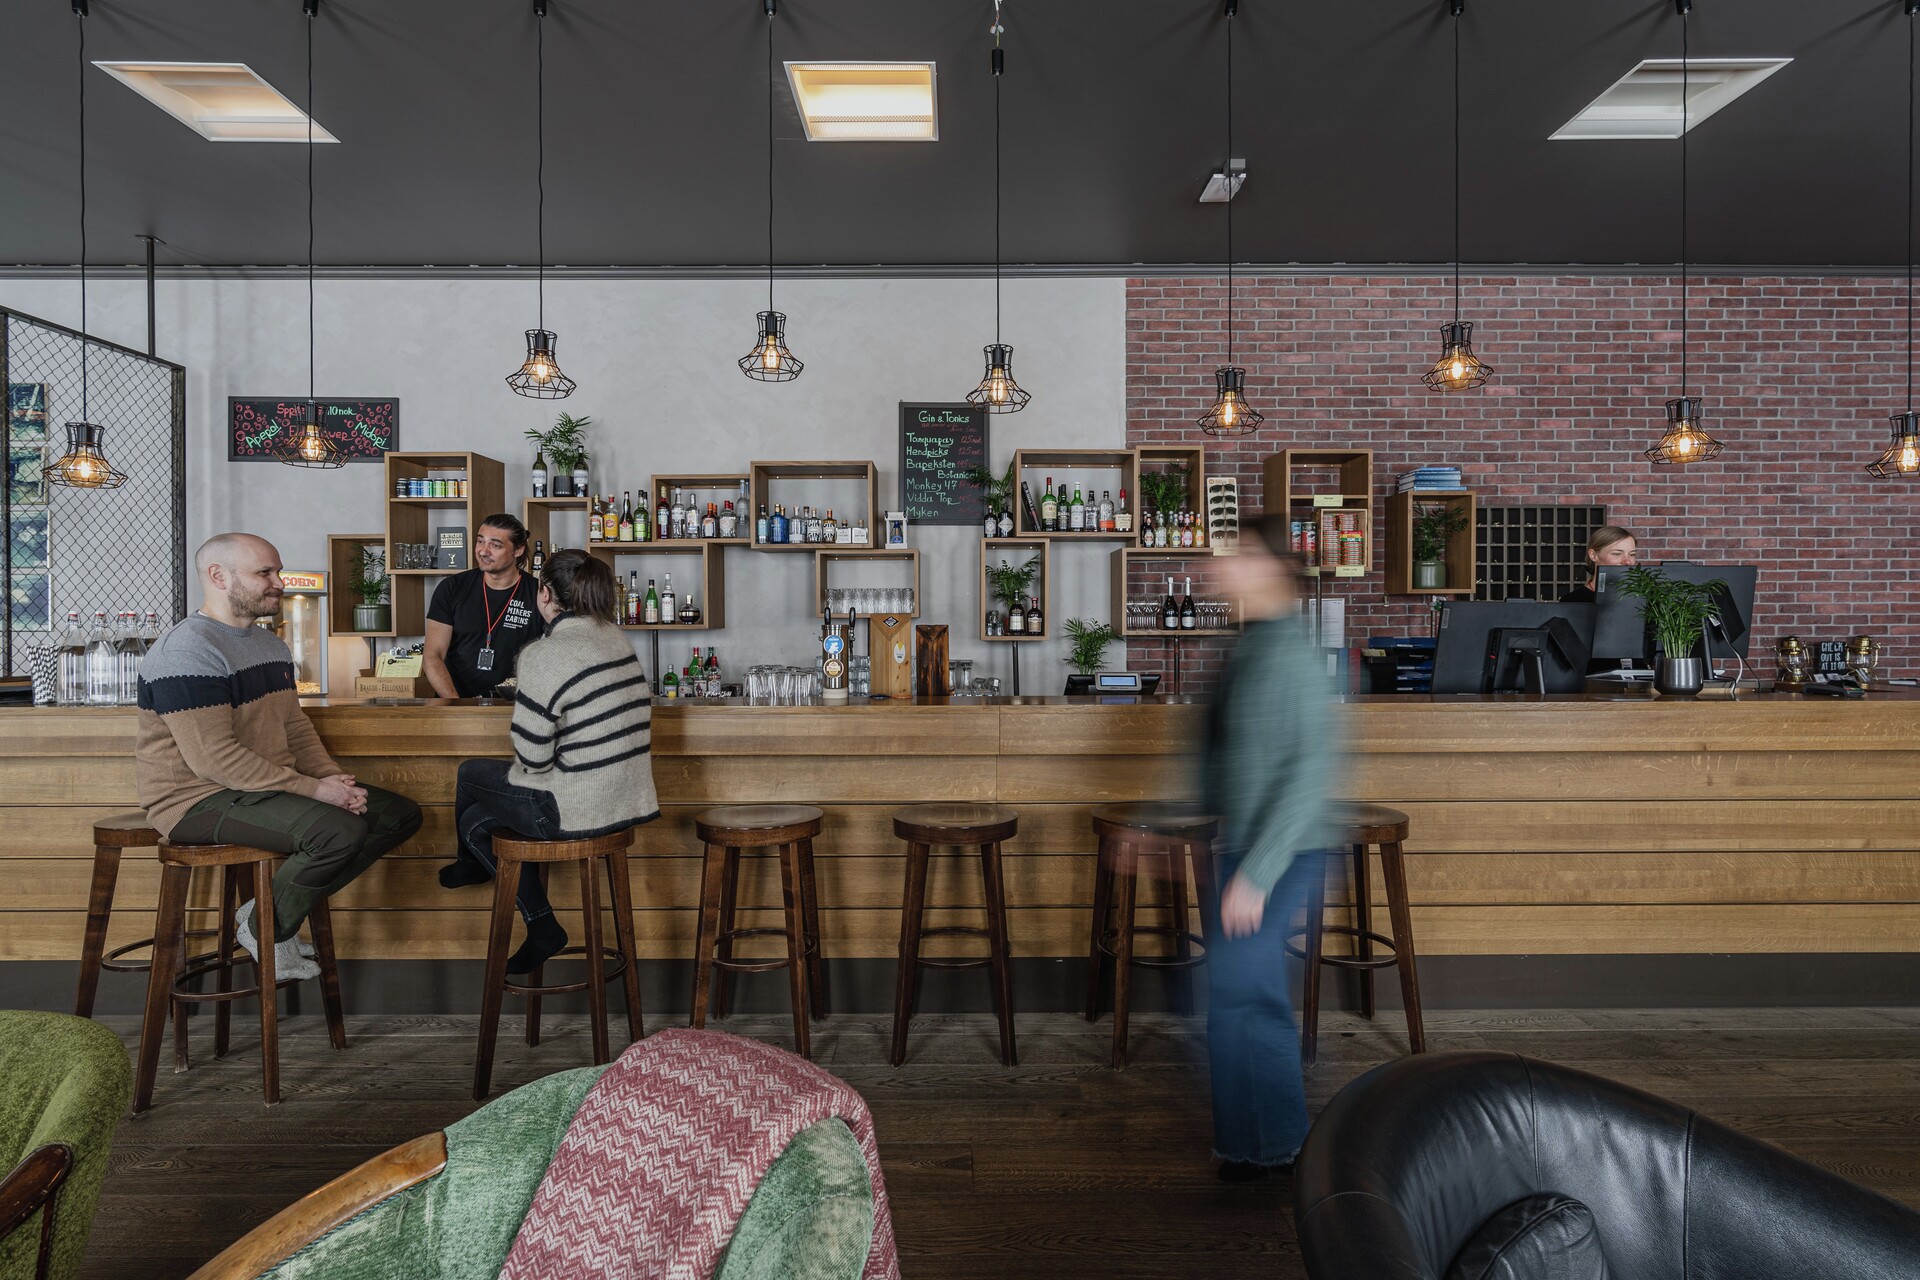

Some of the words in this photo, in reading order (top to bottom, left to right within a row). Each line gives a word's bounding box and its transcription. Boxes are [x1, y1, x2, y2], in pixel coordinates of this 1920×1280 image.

[918, 410, 936, 423] Gin
[937, 414, 943, 422] &
[942, 411, 970, 423] Tonics
[245, 418, 282, 448] Aperol
[354, 421, 390, 450] Midori
[906, 478, 942, 493] Monkey
[944, 480, 958, 490] 47
[906, 493, 933, 502] Vidda
[905, 506, 939, 518] Myken
[509, 599, 525, 609] COAL
[505, 614, 529, 625] CABINS
[1821, 642, 1843, 652] CHECK
[1820, 653, 1832, 662] OUT
[1834, 652, 1841, 661] IS
[1821, 662, 1828, 670] AT
